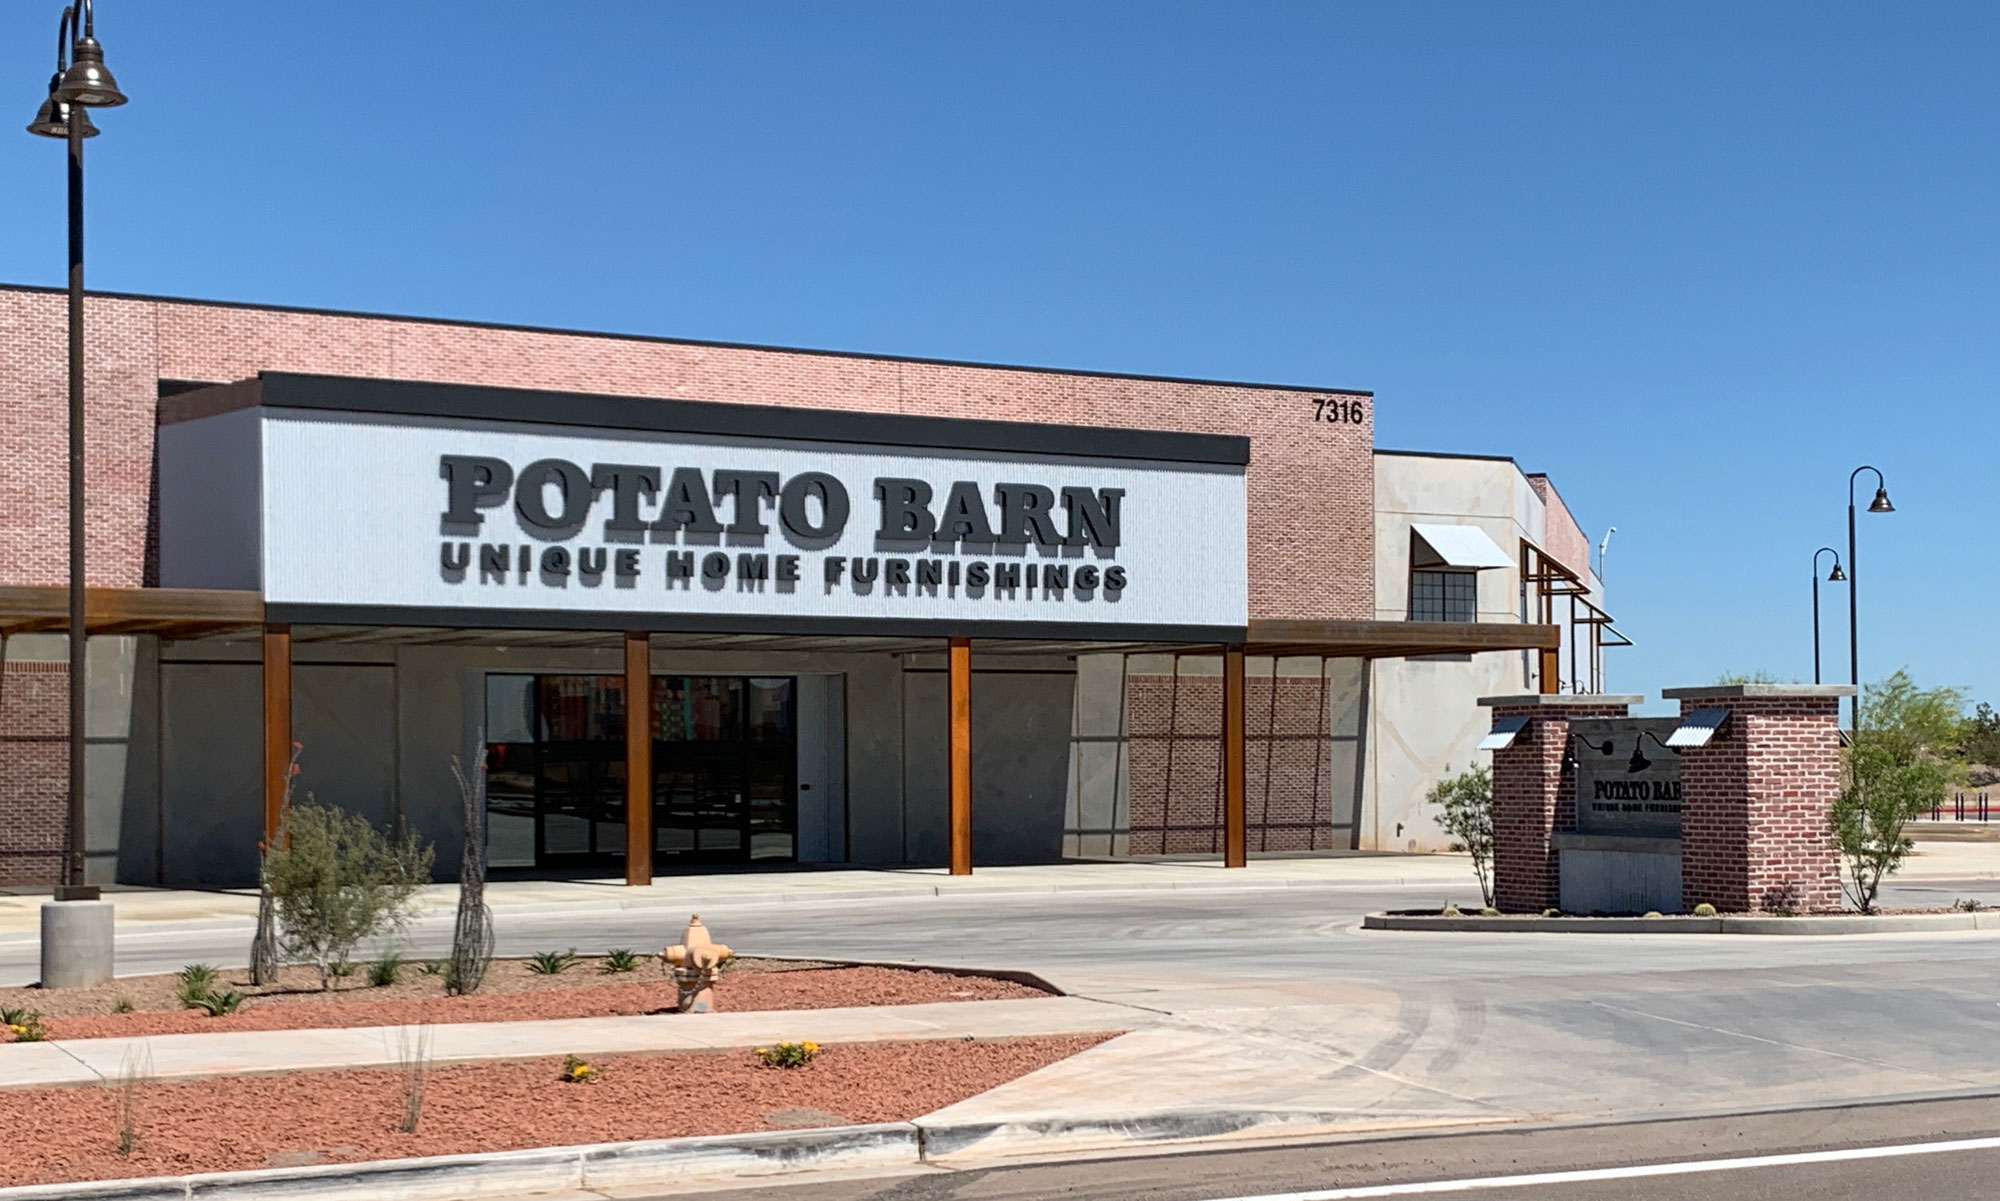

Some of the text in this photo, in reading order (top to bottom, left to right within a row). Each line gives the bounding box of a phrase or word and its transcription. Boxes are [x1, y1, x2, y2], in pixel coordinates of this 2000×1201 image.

[1312, 398, 1363, 425] 7316
[439, 454, 1126, 548] POTATO BARN
[439, 542, 1127, 591] UNIQUE HOME FURNISHINGS
[1594, 780, 1681, 801] POTATO BAR
